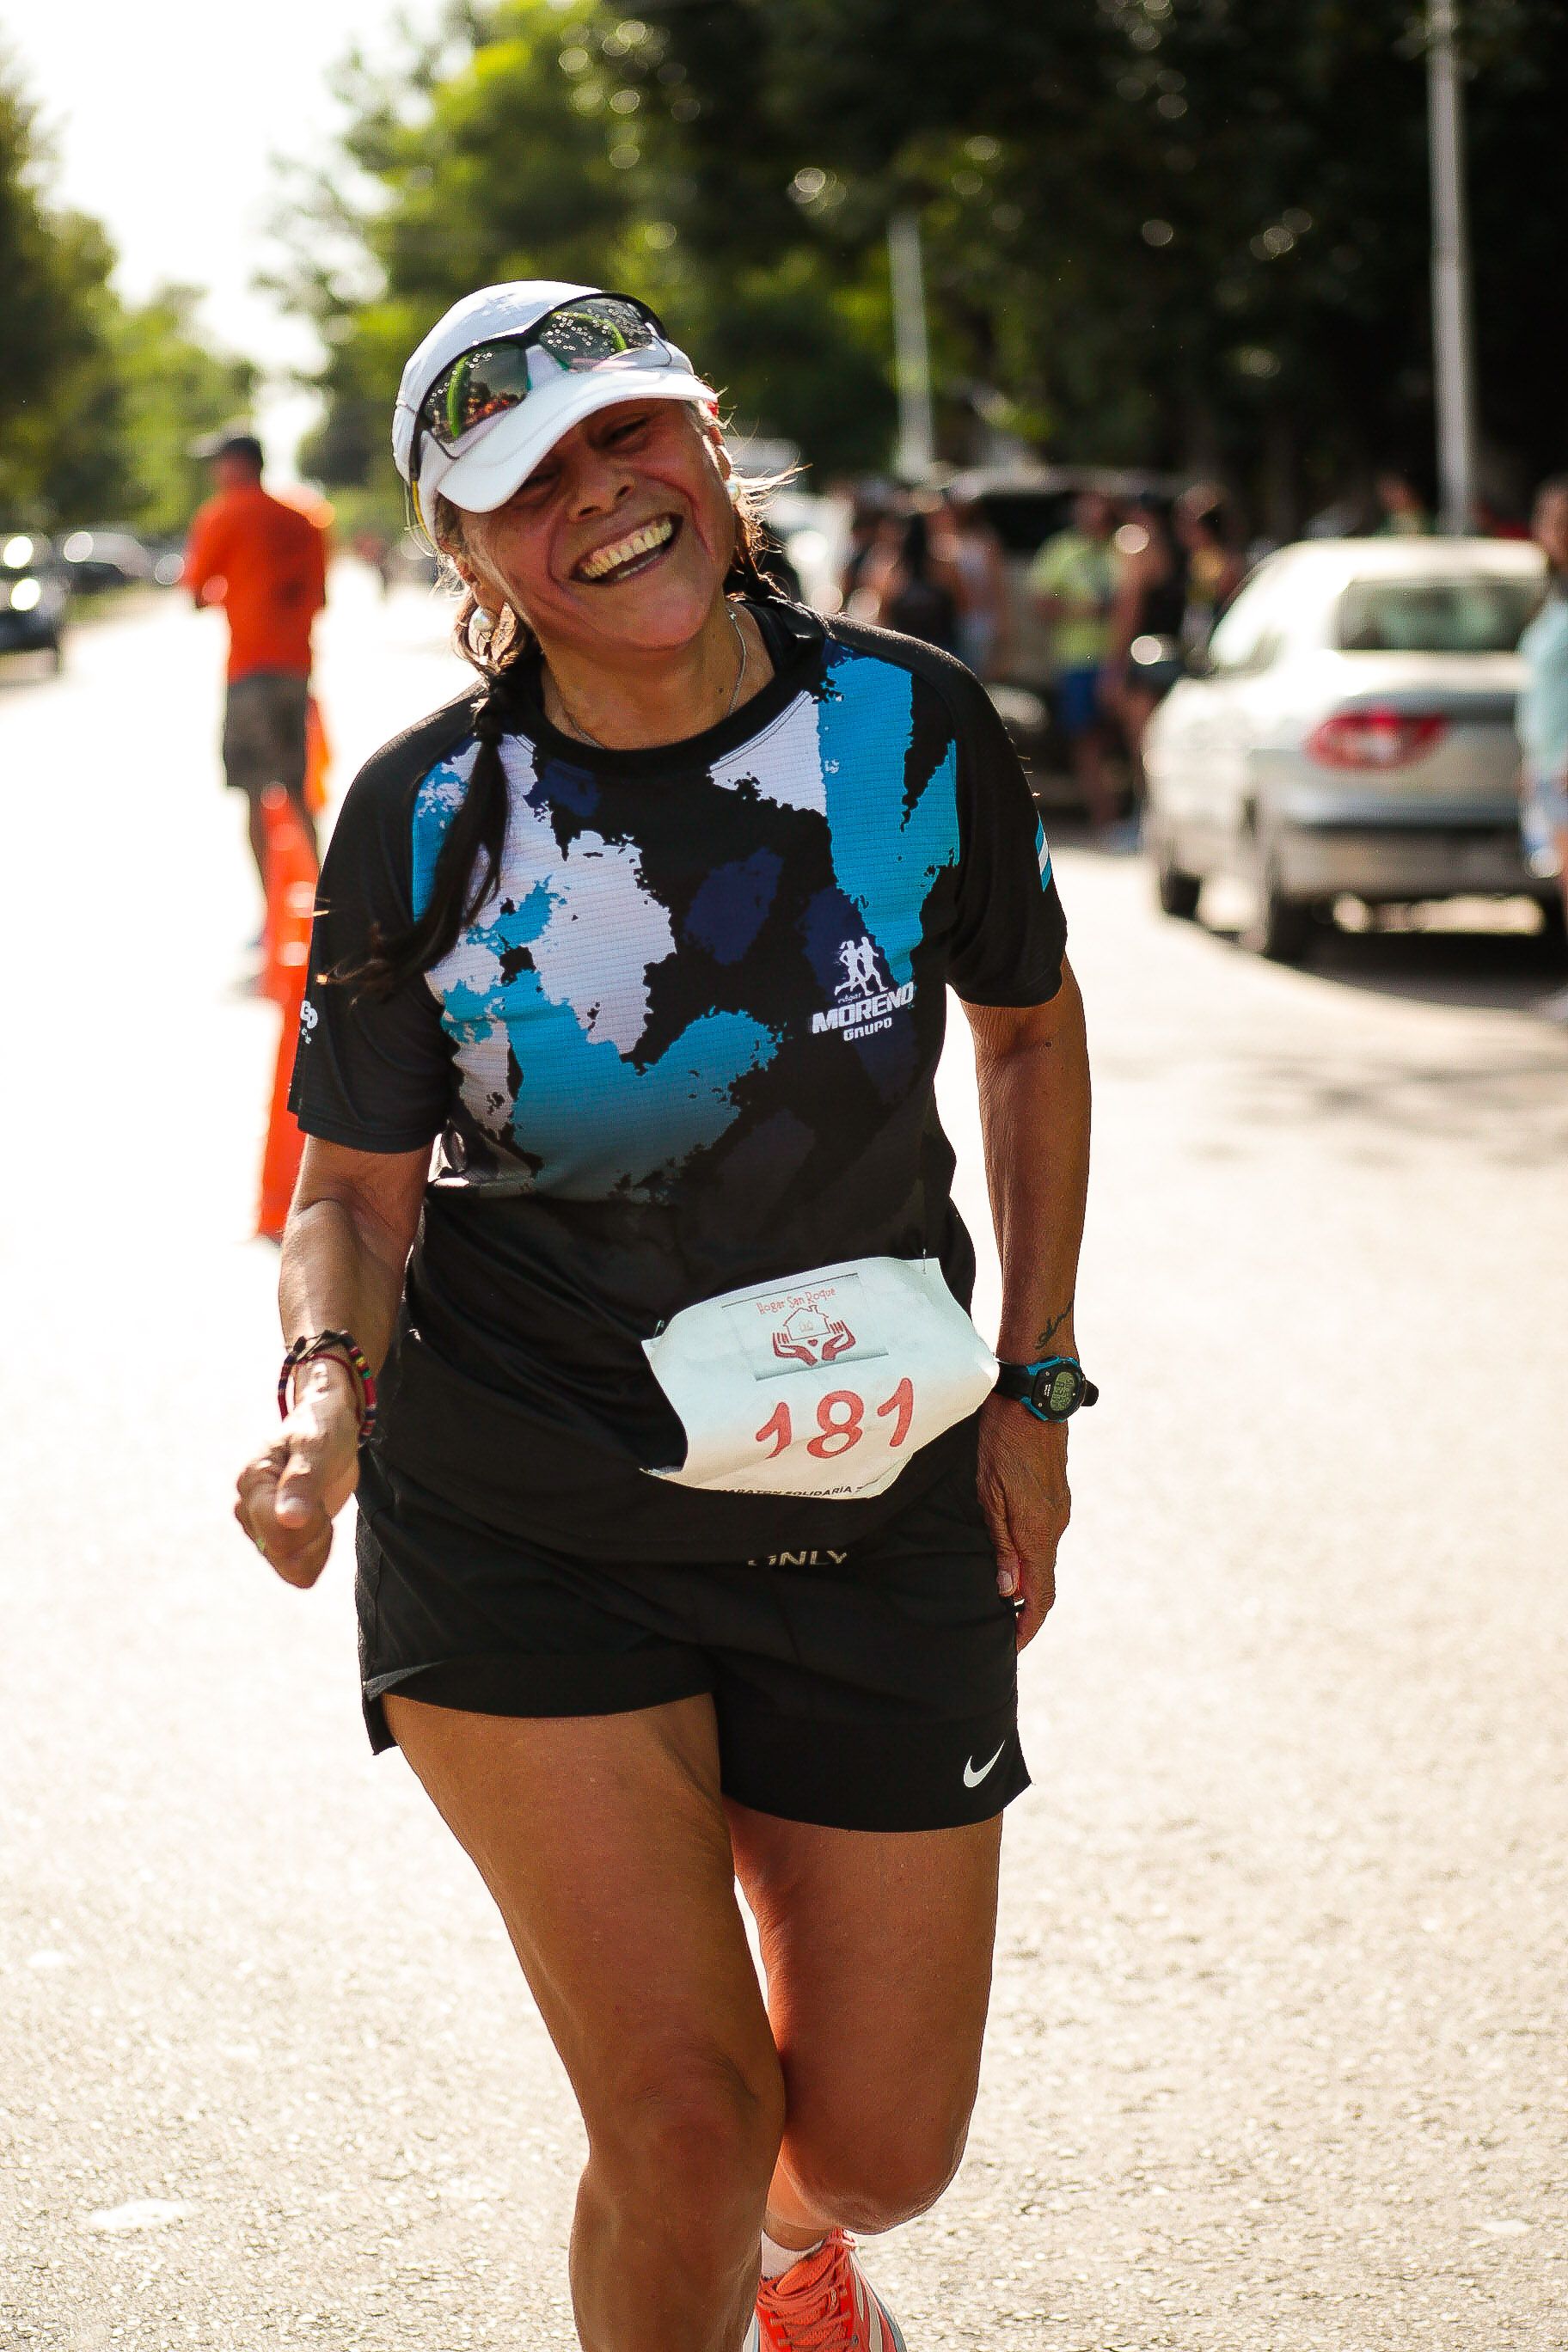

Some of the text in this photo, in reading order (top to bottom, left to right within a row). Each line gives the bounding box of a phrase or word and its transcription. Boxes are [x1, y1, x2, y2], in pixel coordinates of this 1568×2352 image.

[812, 981, 915, 1034] MORENO
[843, 1017, 892, 1041] GRUPO
[756, 1288, 836, 1314] Hogar San Roque
[756, 1377, 914, 1460] 181
